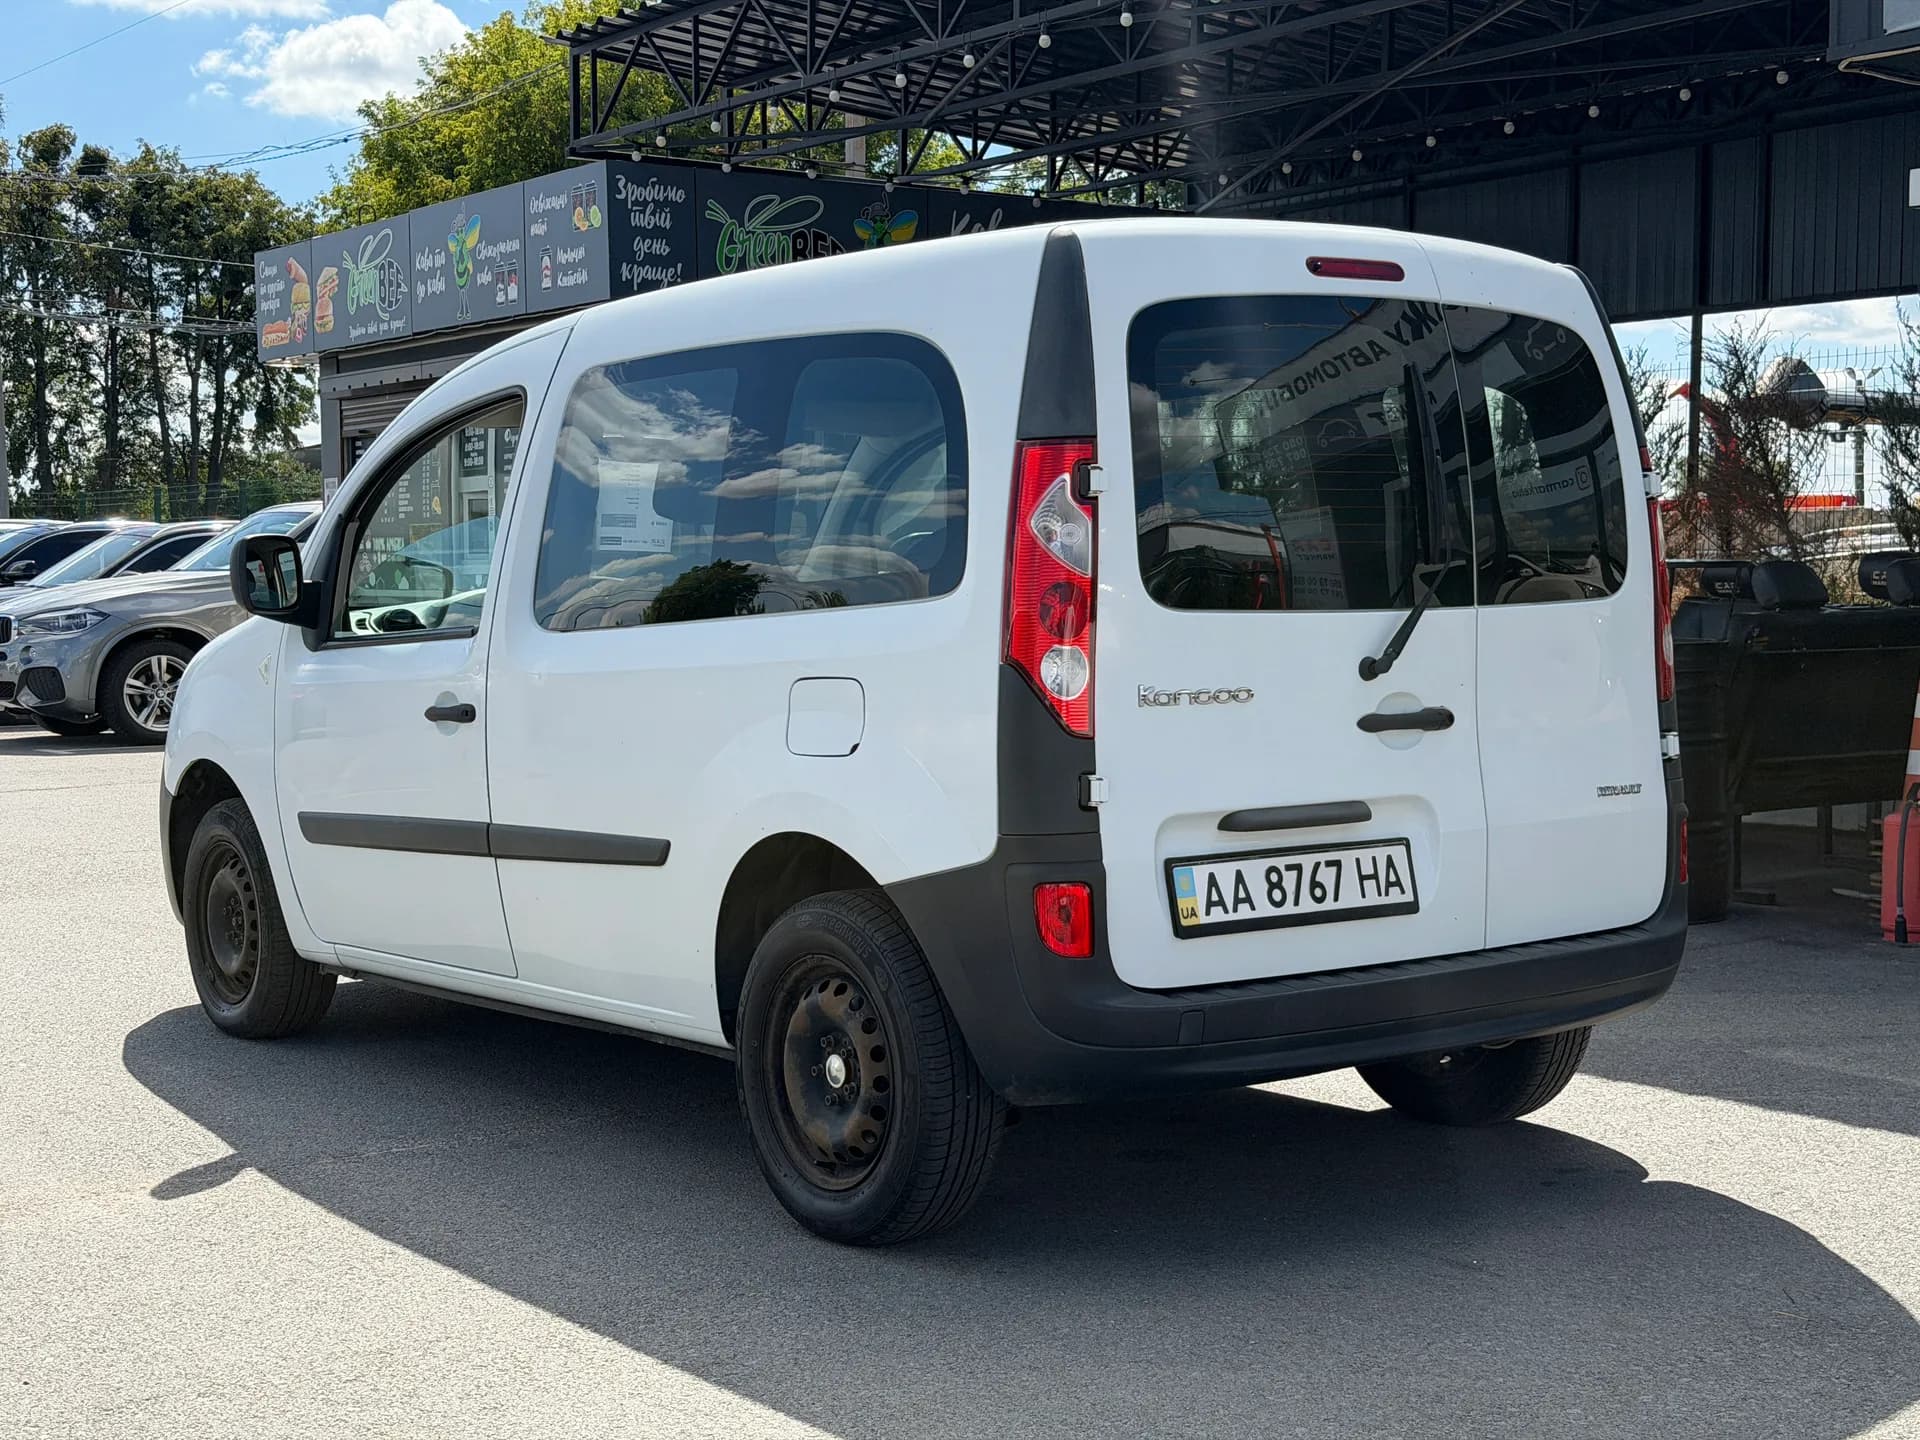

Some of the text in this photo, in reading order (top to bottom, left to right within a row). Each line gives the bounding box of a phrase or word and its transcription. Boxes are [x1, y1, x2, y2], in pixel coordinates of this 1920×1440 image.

[615, 175, 686, 209] Зробимо
[630, 202, 672, 230] твій
[633, 236, 671, 262] день
[620, 262, 683, 291] краще!
[1138, 684, 1254, 707] Kangoo
[1205, 854, 1406, 916] AA 8767 HA
[1180, 906, 1198, 920] UA
